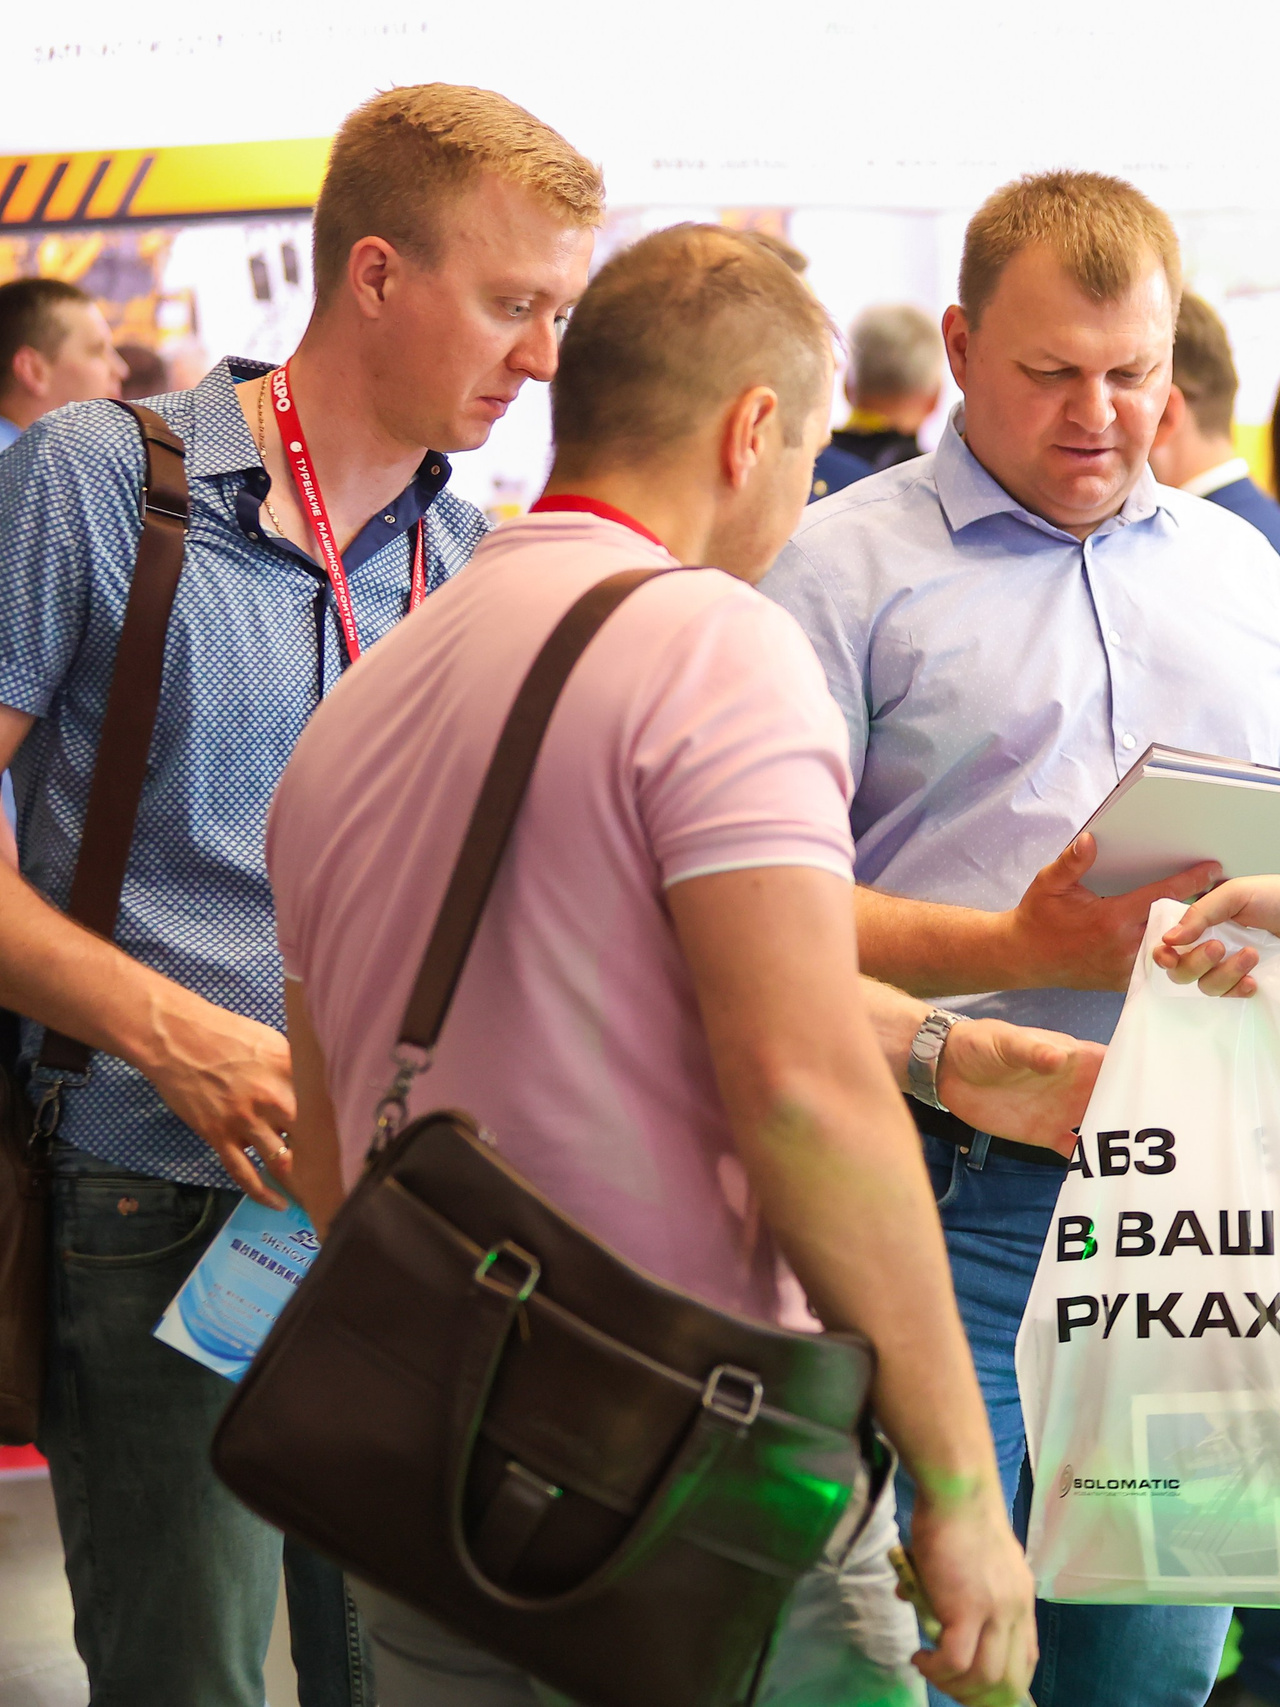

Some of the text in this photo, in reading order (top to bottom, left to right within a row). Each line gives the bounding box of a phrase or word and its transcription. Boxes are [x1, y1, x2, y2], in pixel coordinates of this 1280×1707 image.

[272, 370, 291, 412] EXPO
[296, 458, 356, 641] ТУРЕЦКИЕ МАШИНОСТРОИТЕЛИ
[1063, 1127, 1176, 1182] АБЗ
[1056, 1214, 1098, 1262] В
[1073, 1478, 1180, 1489] SOLOMATIC
